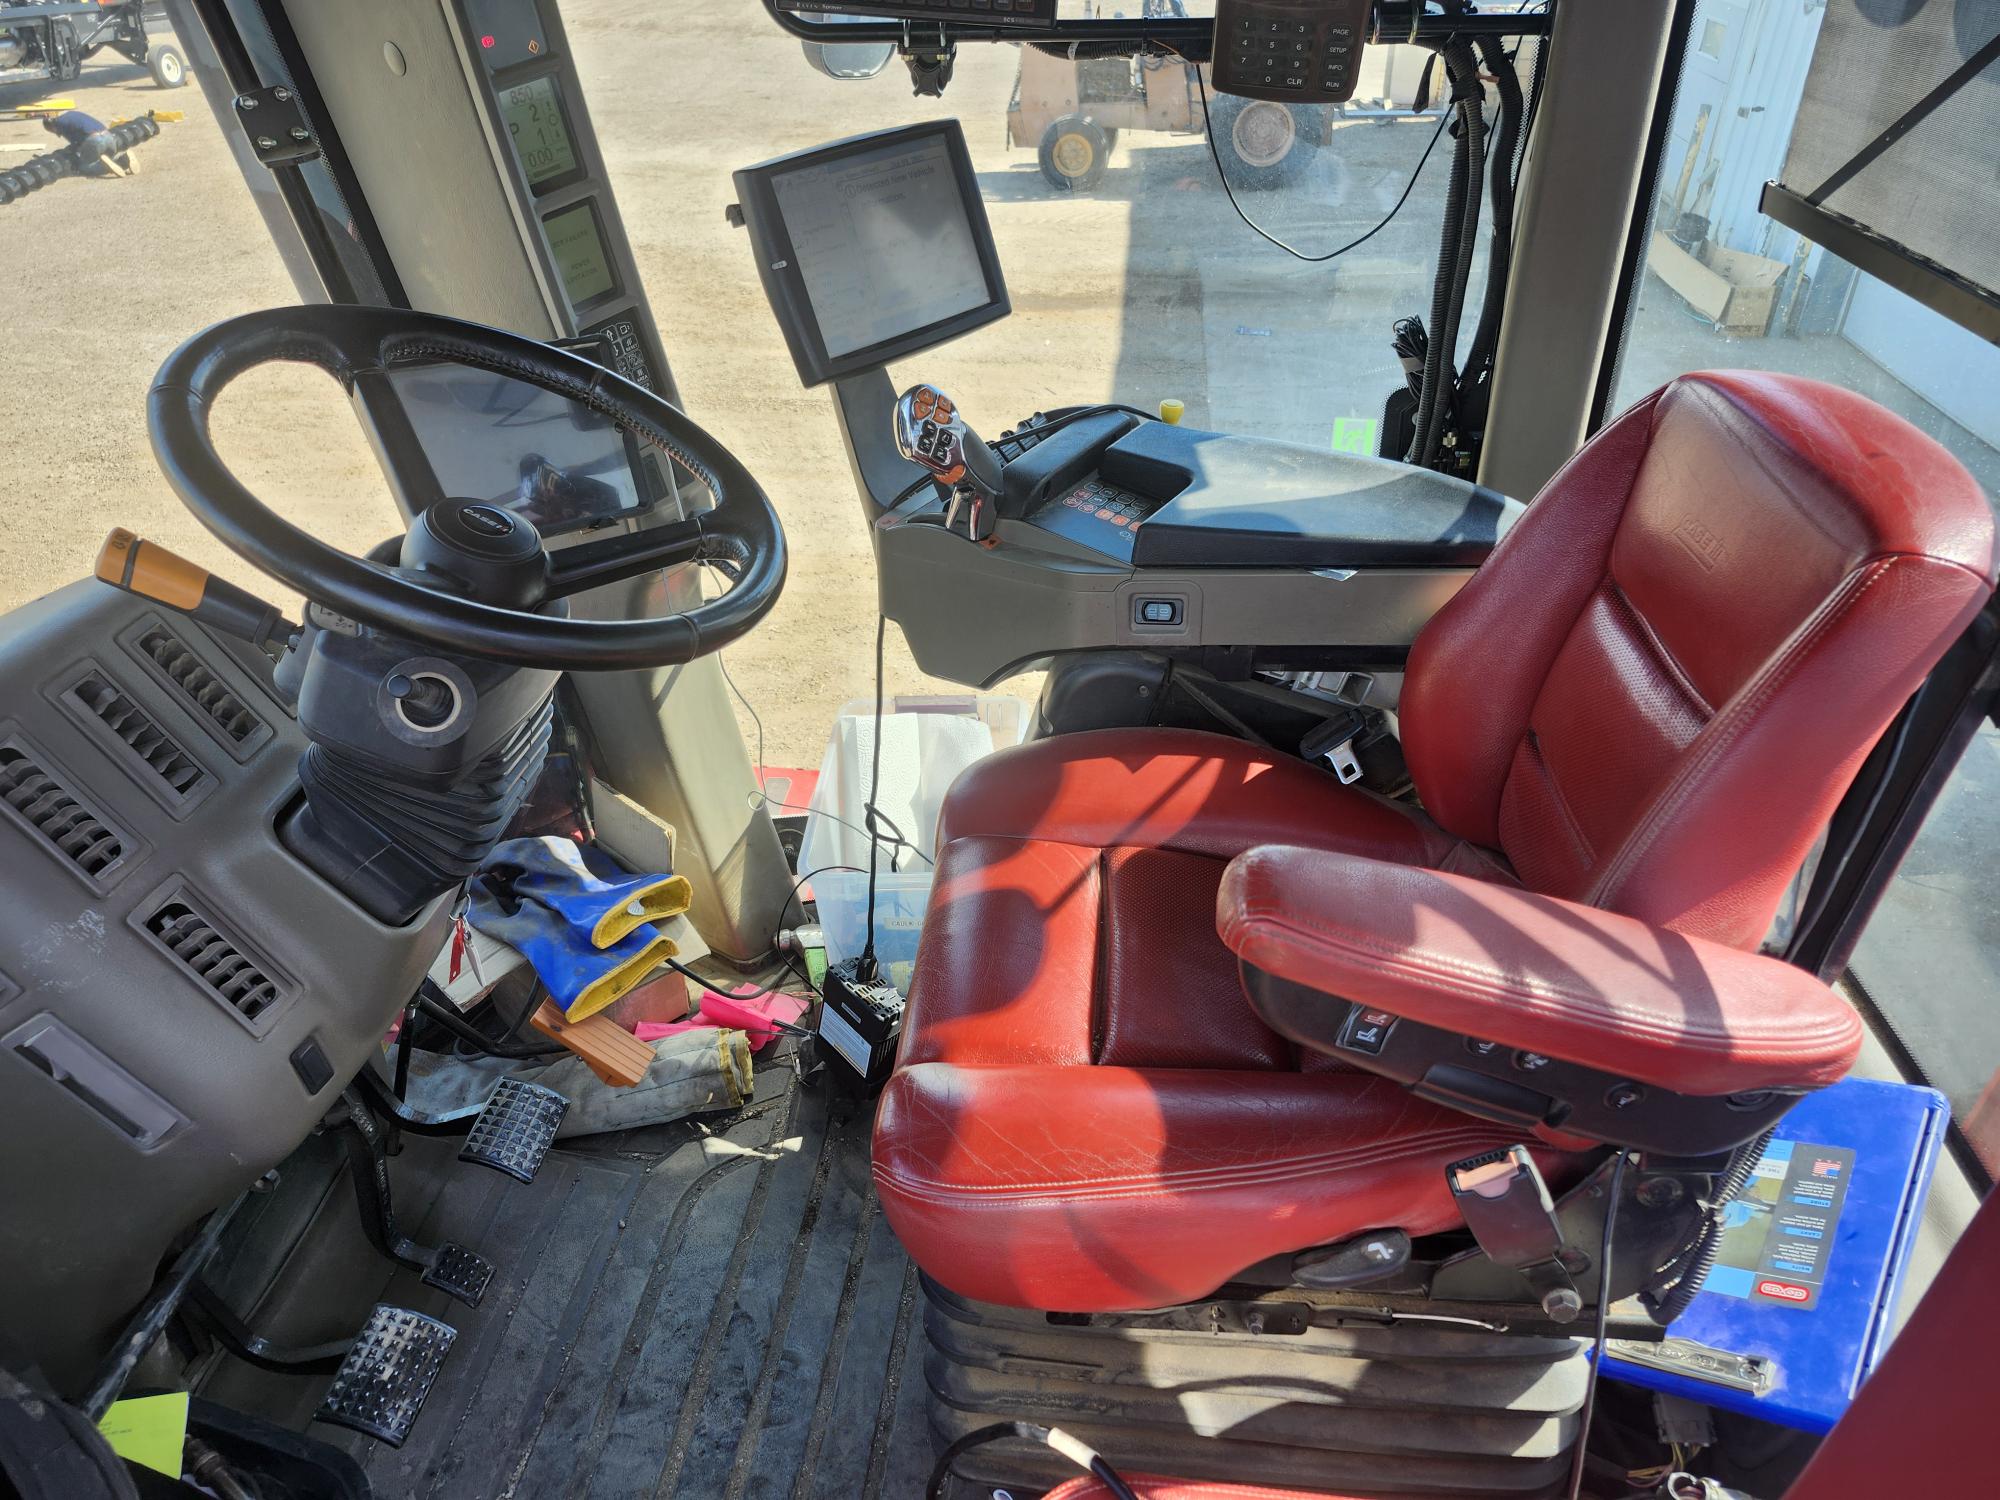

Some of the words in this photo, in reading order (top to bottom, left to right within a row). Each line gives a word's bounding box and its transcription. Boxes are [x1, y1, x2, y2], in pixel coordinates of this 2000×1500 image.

[1332, 28, 1349, 36] PAGE
[1269, 41, 1275, 49] 5
[1296, 43, 1302, 51] 6
[1329, 46, 1347, 54] SETUP
[1294, 60, 1300, 68] 9
[1287, 77, 1303, 86] CLR
[511, 85, 534, 106] 850
[528, 103, 541, 123] 2
[536, 127, 547, 145] 1
